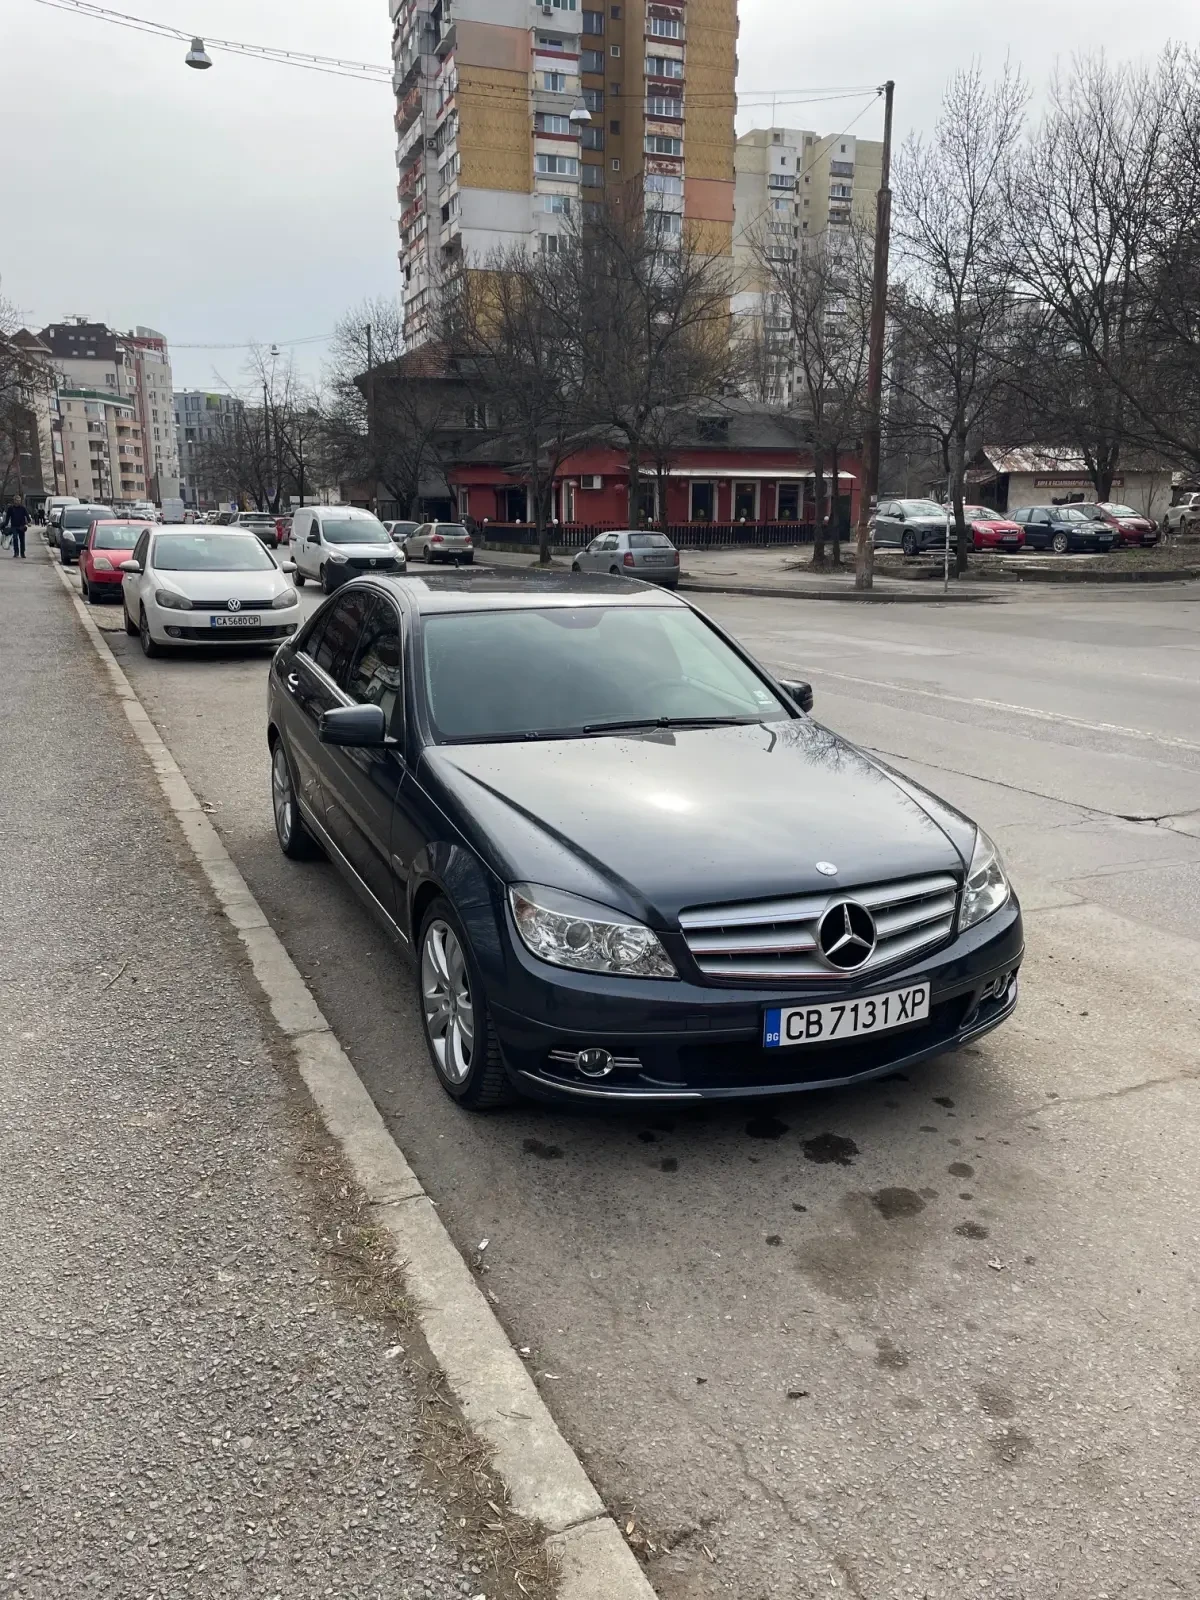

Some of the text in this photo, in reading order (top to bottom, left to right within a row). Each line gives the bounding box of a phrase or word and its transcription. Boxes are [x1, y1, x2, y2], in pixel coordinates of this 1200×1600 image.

[216, 617, 259, 626] CA 5680 CP
[786, 987, 926, 1041] CB 7131 XP
[766, 1032, 779, 1042] BG
